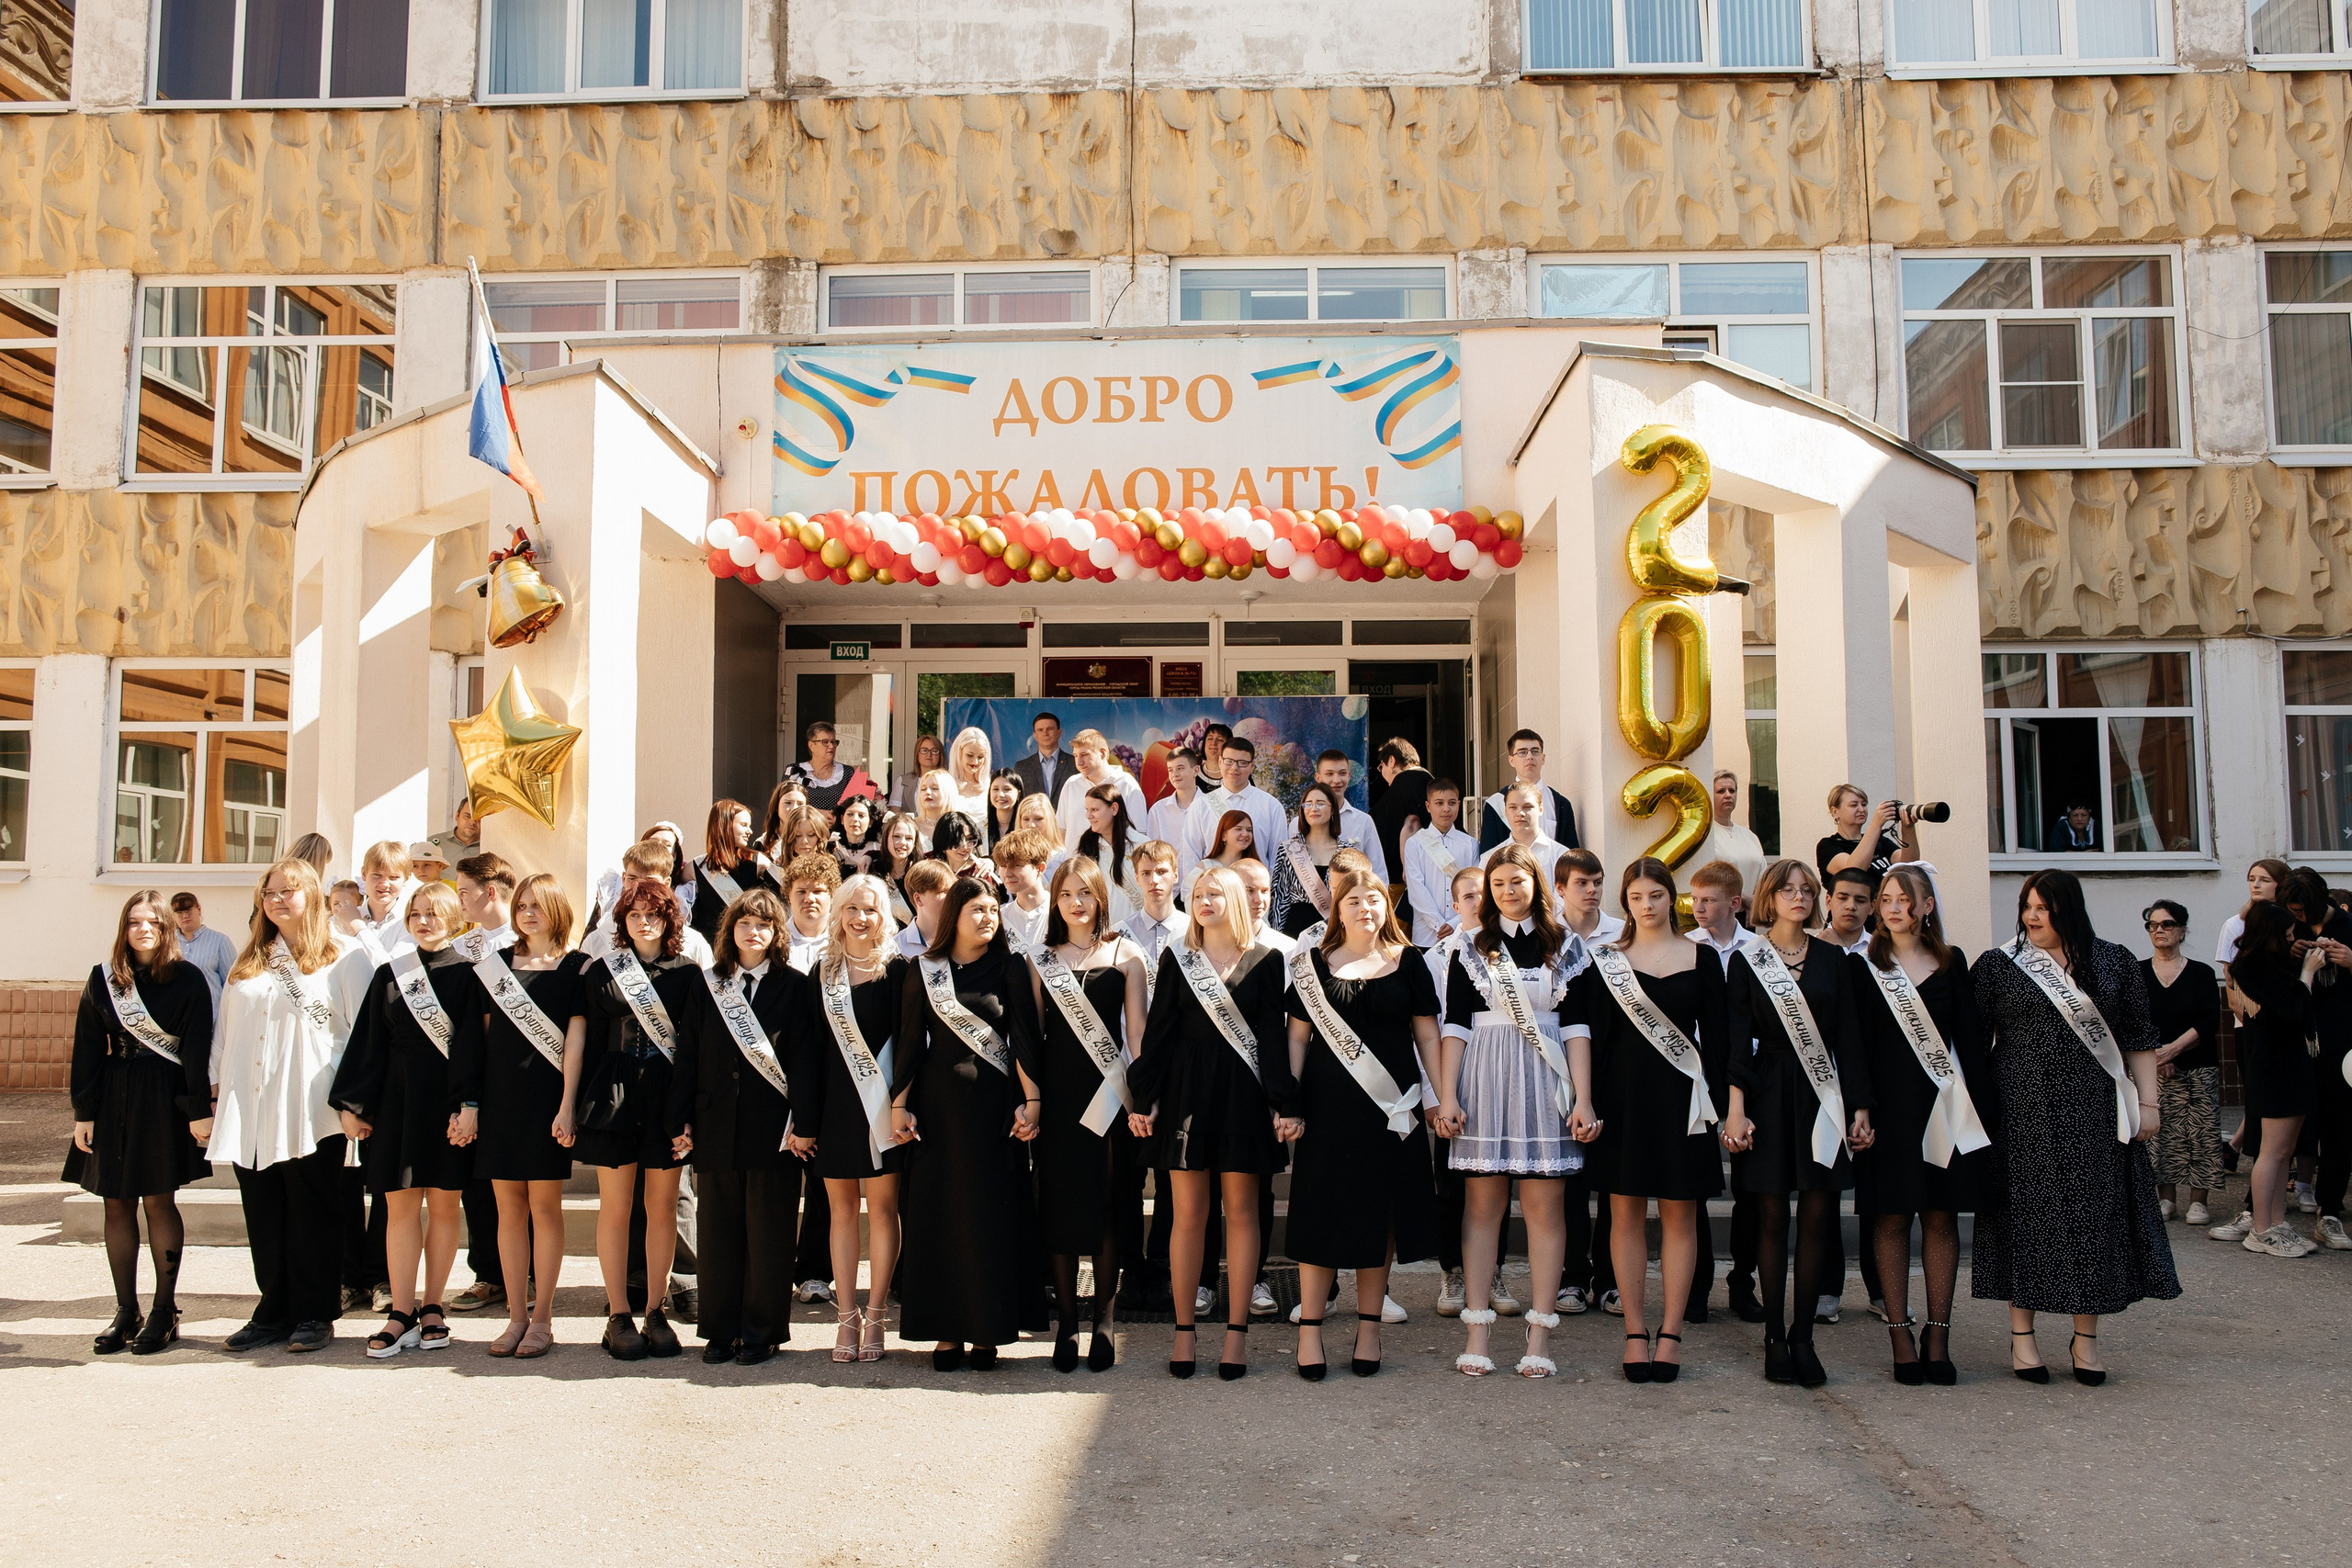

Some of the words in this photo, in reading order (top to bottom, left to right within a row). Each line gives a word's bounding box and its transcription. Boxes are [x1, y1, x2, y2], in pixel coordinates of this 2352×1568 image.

[992, 374, 1233, 437] ДОБРО
[848, 466, 1379, 518] ПОЖАЛОВАТЬ!
[837, 646, 864, 659] ВХОД
[1362, 684, 1391, 695] ВХОД
[303, 999, 333, 1025] 2025
[619, 974, 671, 1047] Выпускник
[931, 989, 993, 1055] Выпускник
[1043, 965, 1097, 1042] Выпускник
[1092, 1036, 1119, 1064] 2025
[1188, 967, 1246, 1043] Выпускница
[1293, 965, 1341, 1041] Выпускница
[1337, 1034, 1366, 1061] 2025
[1602, 962, 1661, 1038] Выпускник
[1659, 1030, 1690, 1057] 2025
[1761, 970, 1815, 1056] Выпускник
[1807, 1054, 1835, 1083] 2025
[1875, 969, 1931, 1052] Выпускник
[1925, 1049, 1955, 1077] 2025
[2018, 951, 2086, 1022] Выпускник
[2080, 1017, 2109, 1043] 2025
[852, 1051, 878, 1077] 2025
